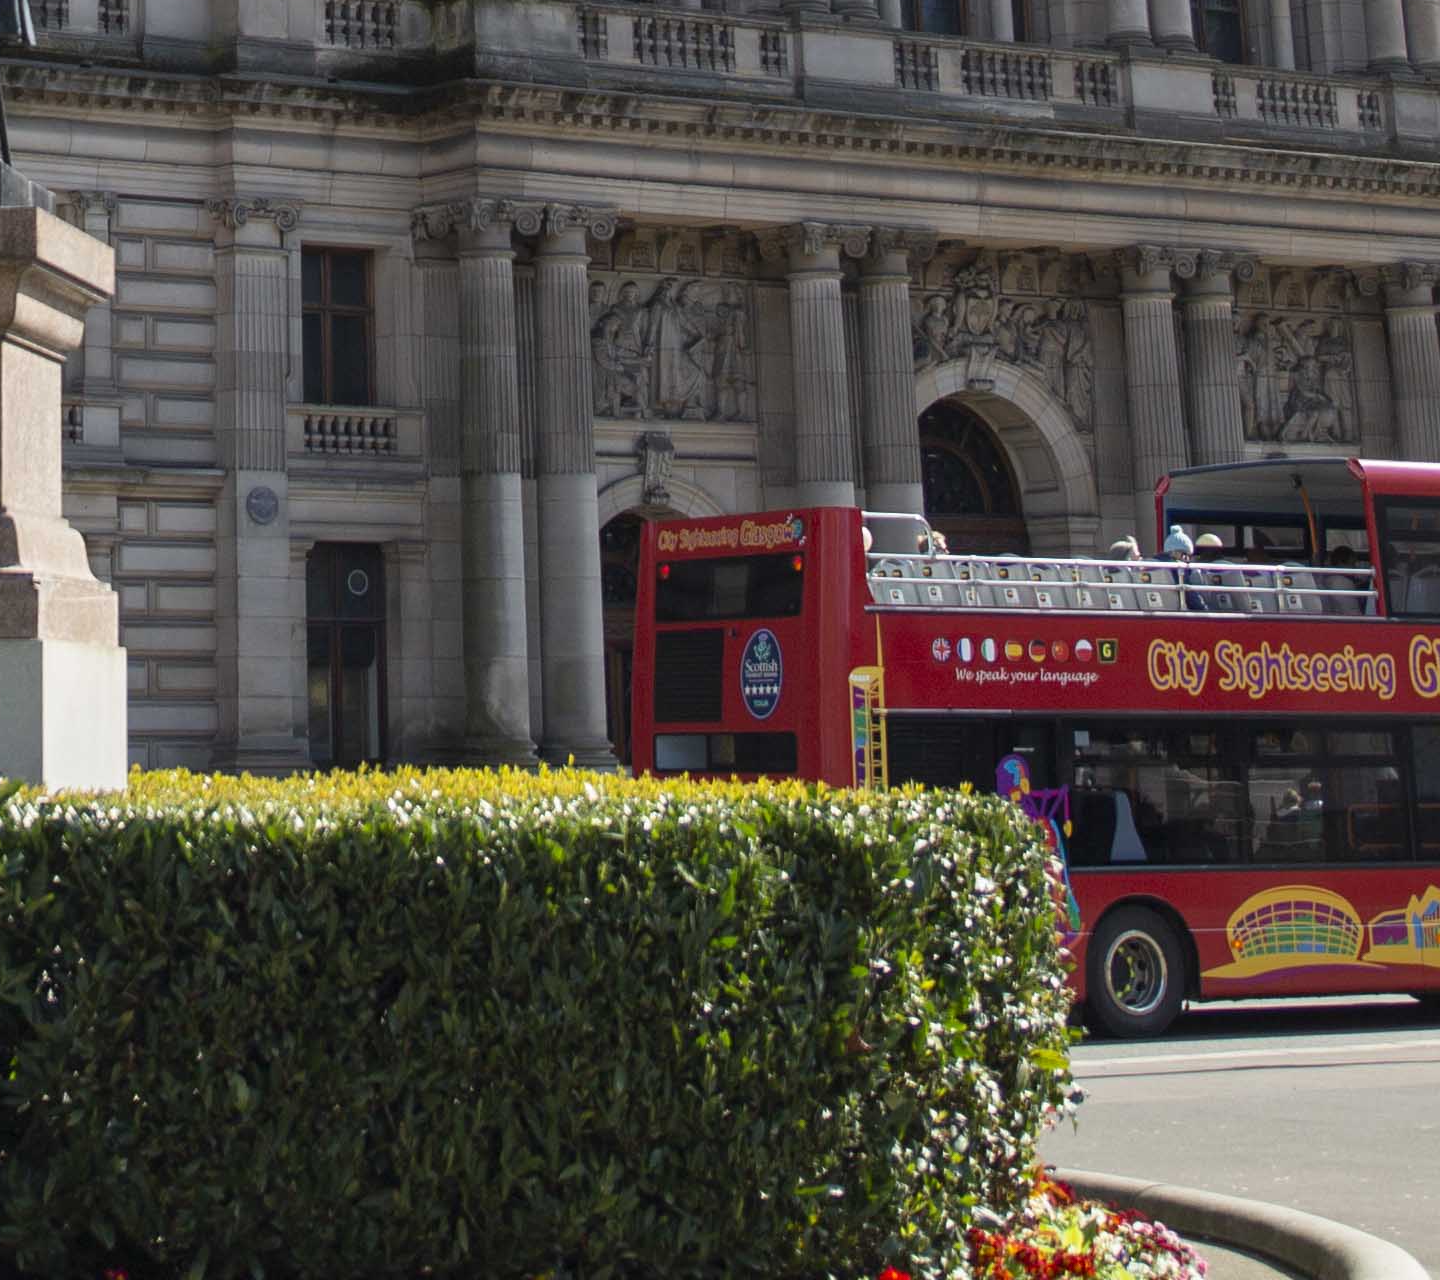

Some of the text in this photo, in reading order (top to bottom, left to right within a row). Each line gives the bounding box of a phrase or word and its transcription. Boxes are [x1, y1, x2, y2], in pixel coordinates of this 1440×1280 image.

[658, 520, 794, 552] City Sightseeing Glasgow
[744, 658, 778, 672] Scottish
[955, 667, 1098, 686] We speak your language
[1148, 639, 1208, 695] City
[1215, 640, 1396, 699] Sightseeing
